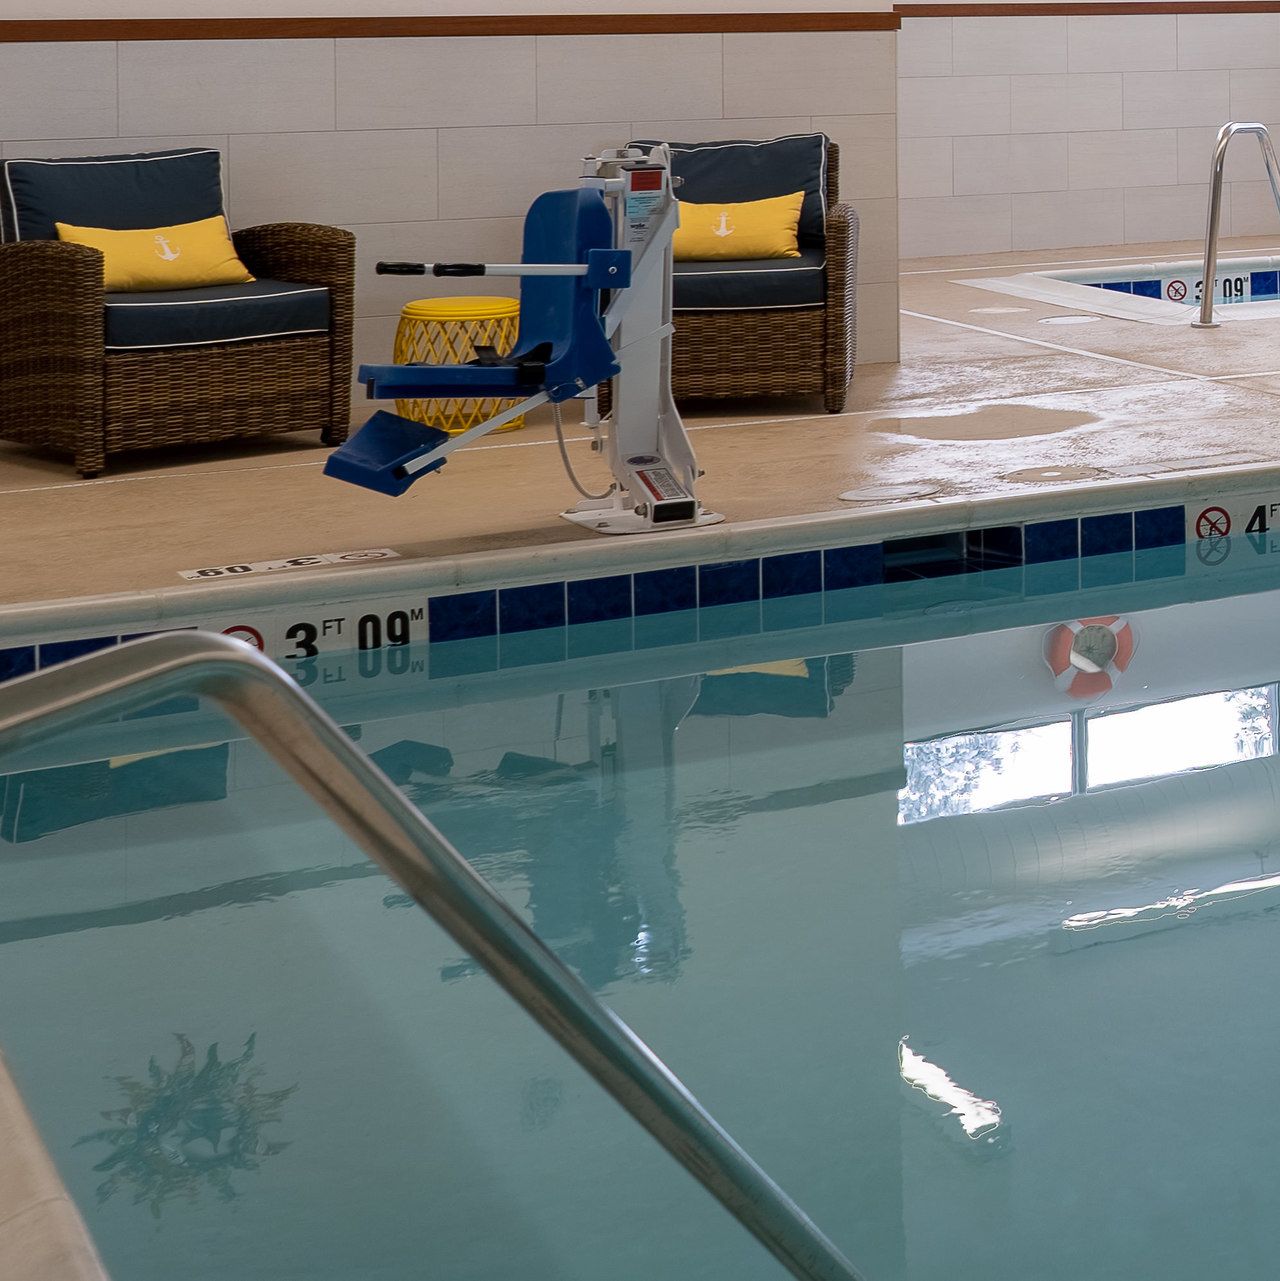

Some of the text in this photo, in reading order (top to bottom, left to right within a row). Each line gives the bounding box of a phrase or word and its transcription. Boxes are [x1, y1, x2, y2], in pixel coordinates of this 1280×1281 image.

[1245, 505, 1270, 533] 4
[285, 622, 319, 659] 3
[322, 618, 345, 636] FT
[410, 607, 424, 621] M
